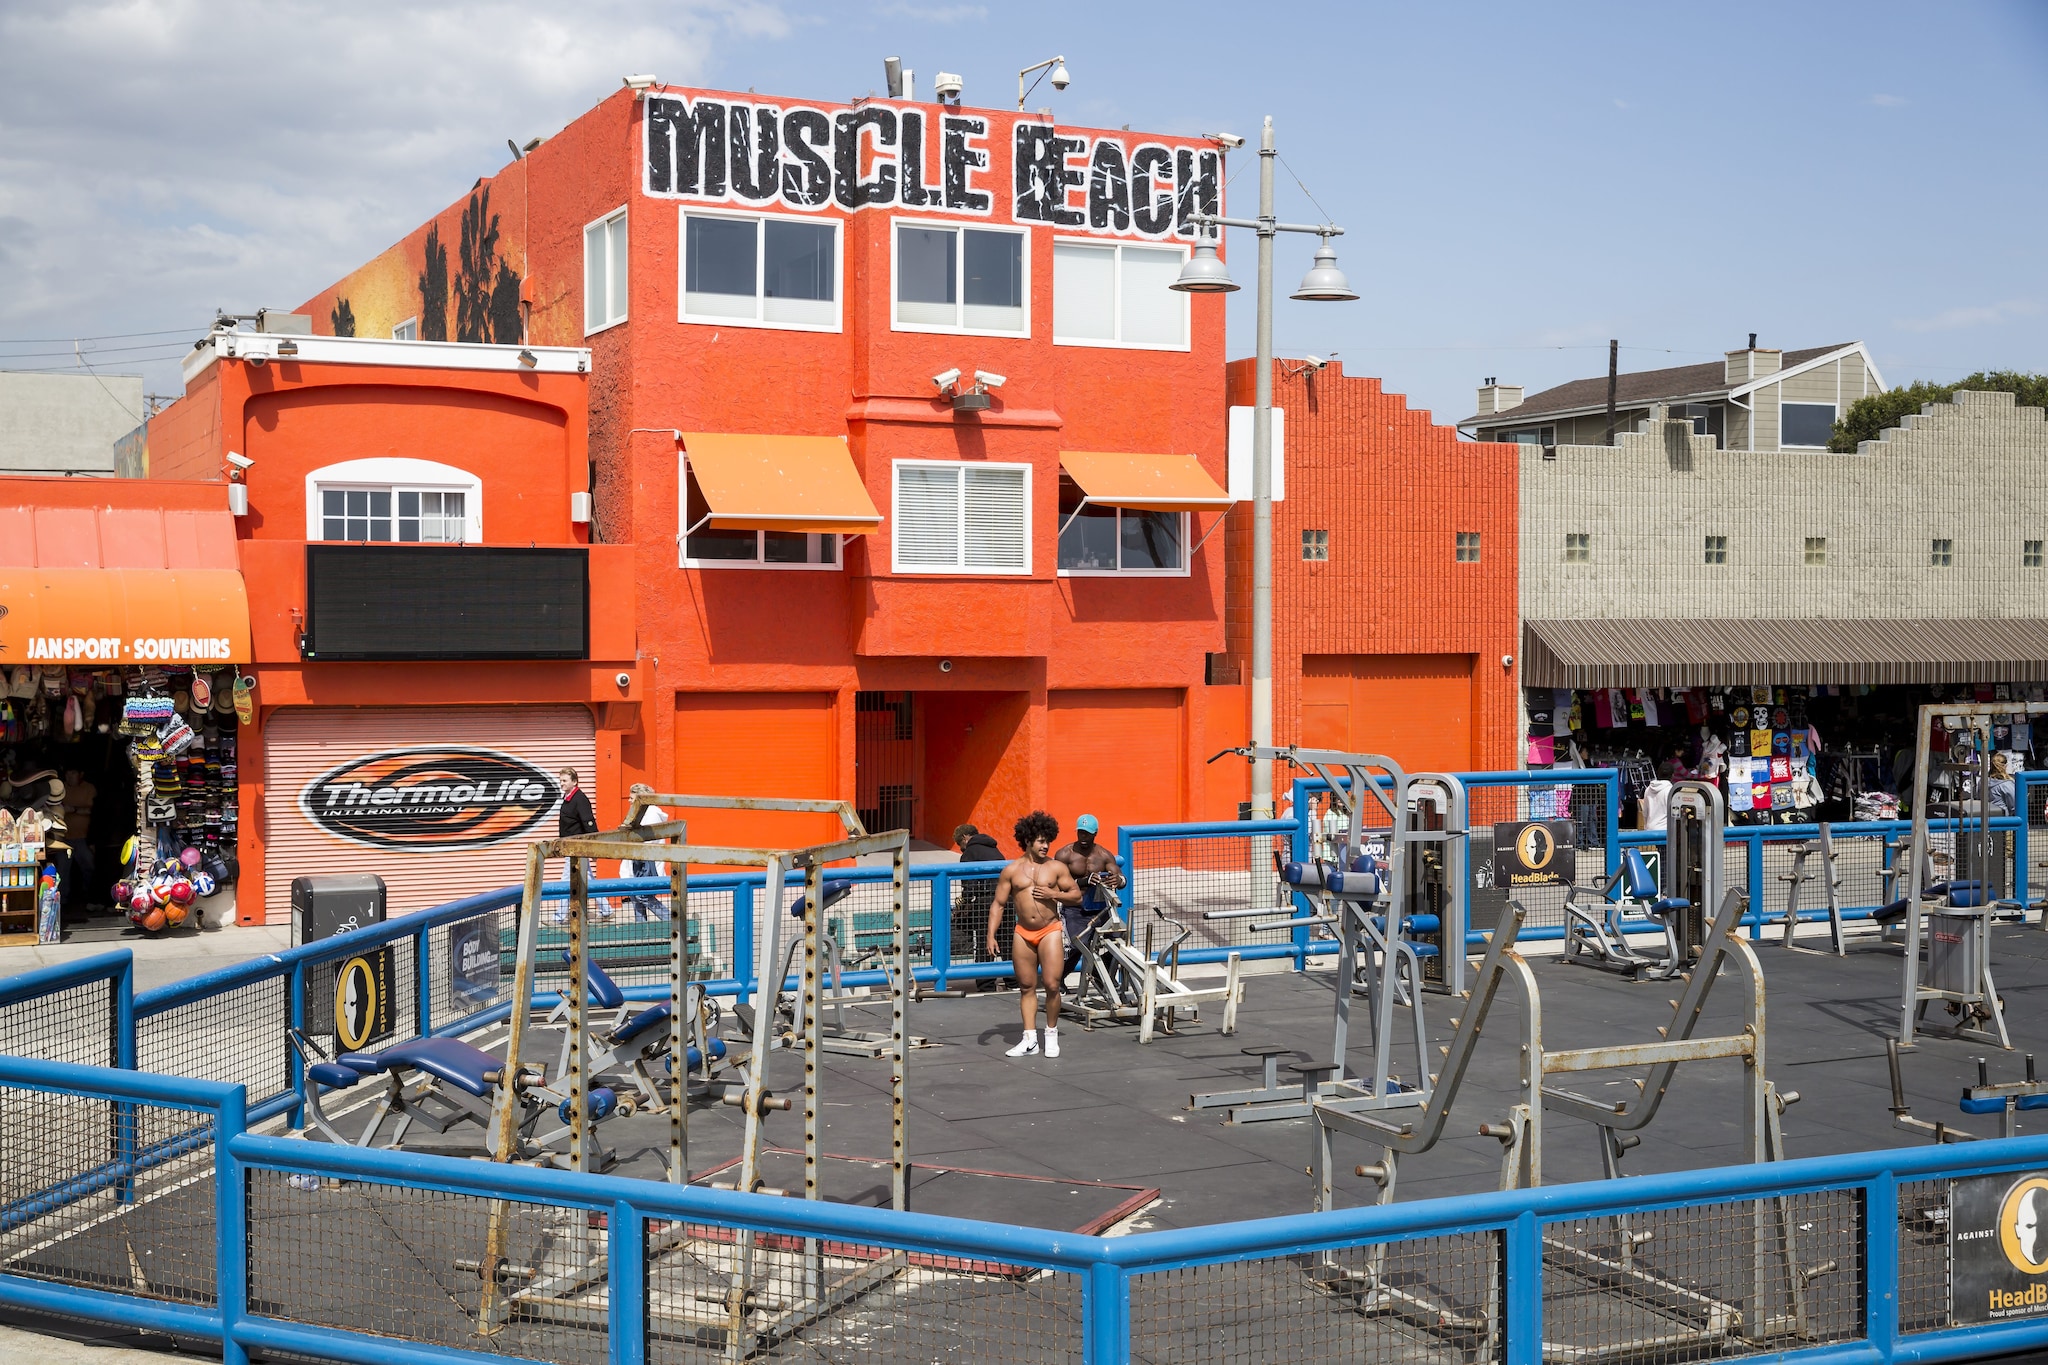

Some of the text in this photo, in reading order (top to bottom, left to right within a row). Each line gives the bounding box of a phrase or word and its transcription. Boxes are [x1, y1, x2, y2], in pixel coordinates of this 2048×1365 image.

[645, 94, 1222, 240] MUSCLE BEACH
[27, 637, 230, 660] JANSPORT SOUVENIRS
[322, 779, 545, 806] ThermoLife
[322, 806, 466, 816] INTERNATIONAL
[1510, 871, 1559, 883] HeadBlade
[463, 939, 480, 956] BODY
[379, 951, 387, 1033] HeadBlade
[1957, 1229, 1994, 1241] AGAINST
[1990, 1309, 2005, 1318] Proud
[2006, 1308, 2026, 1317] sponsor
[2027, 1305, 2033, 1313] of
